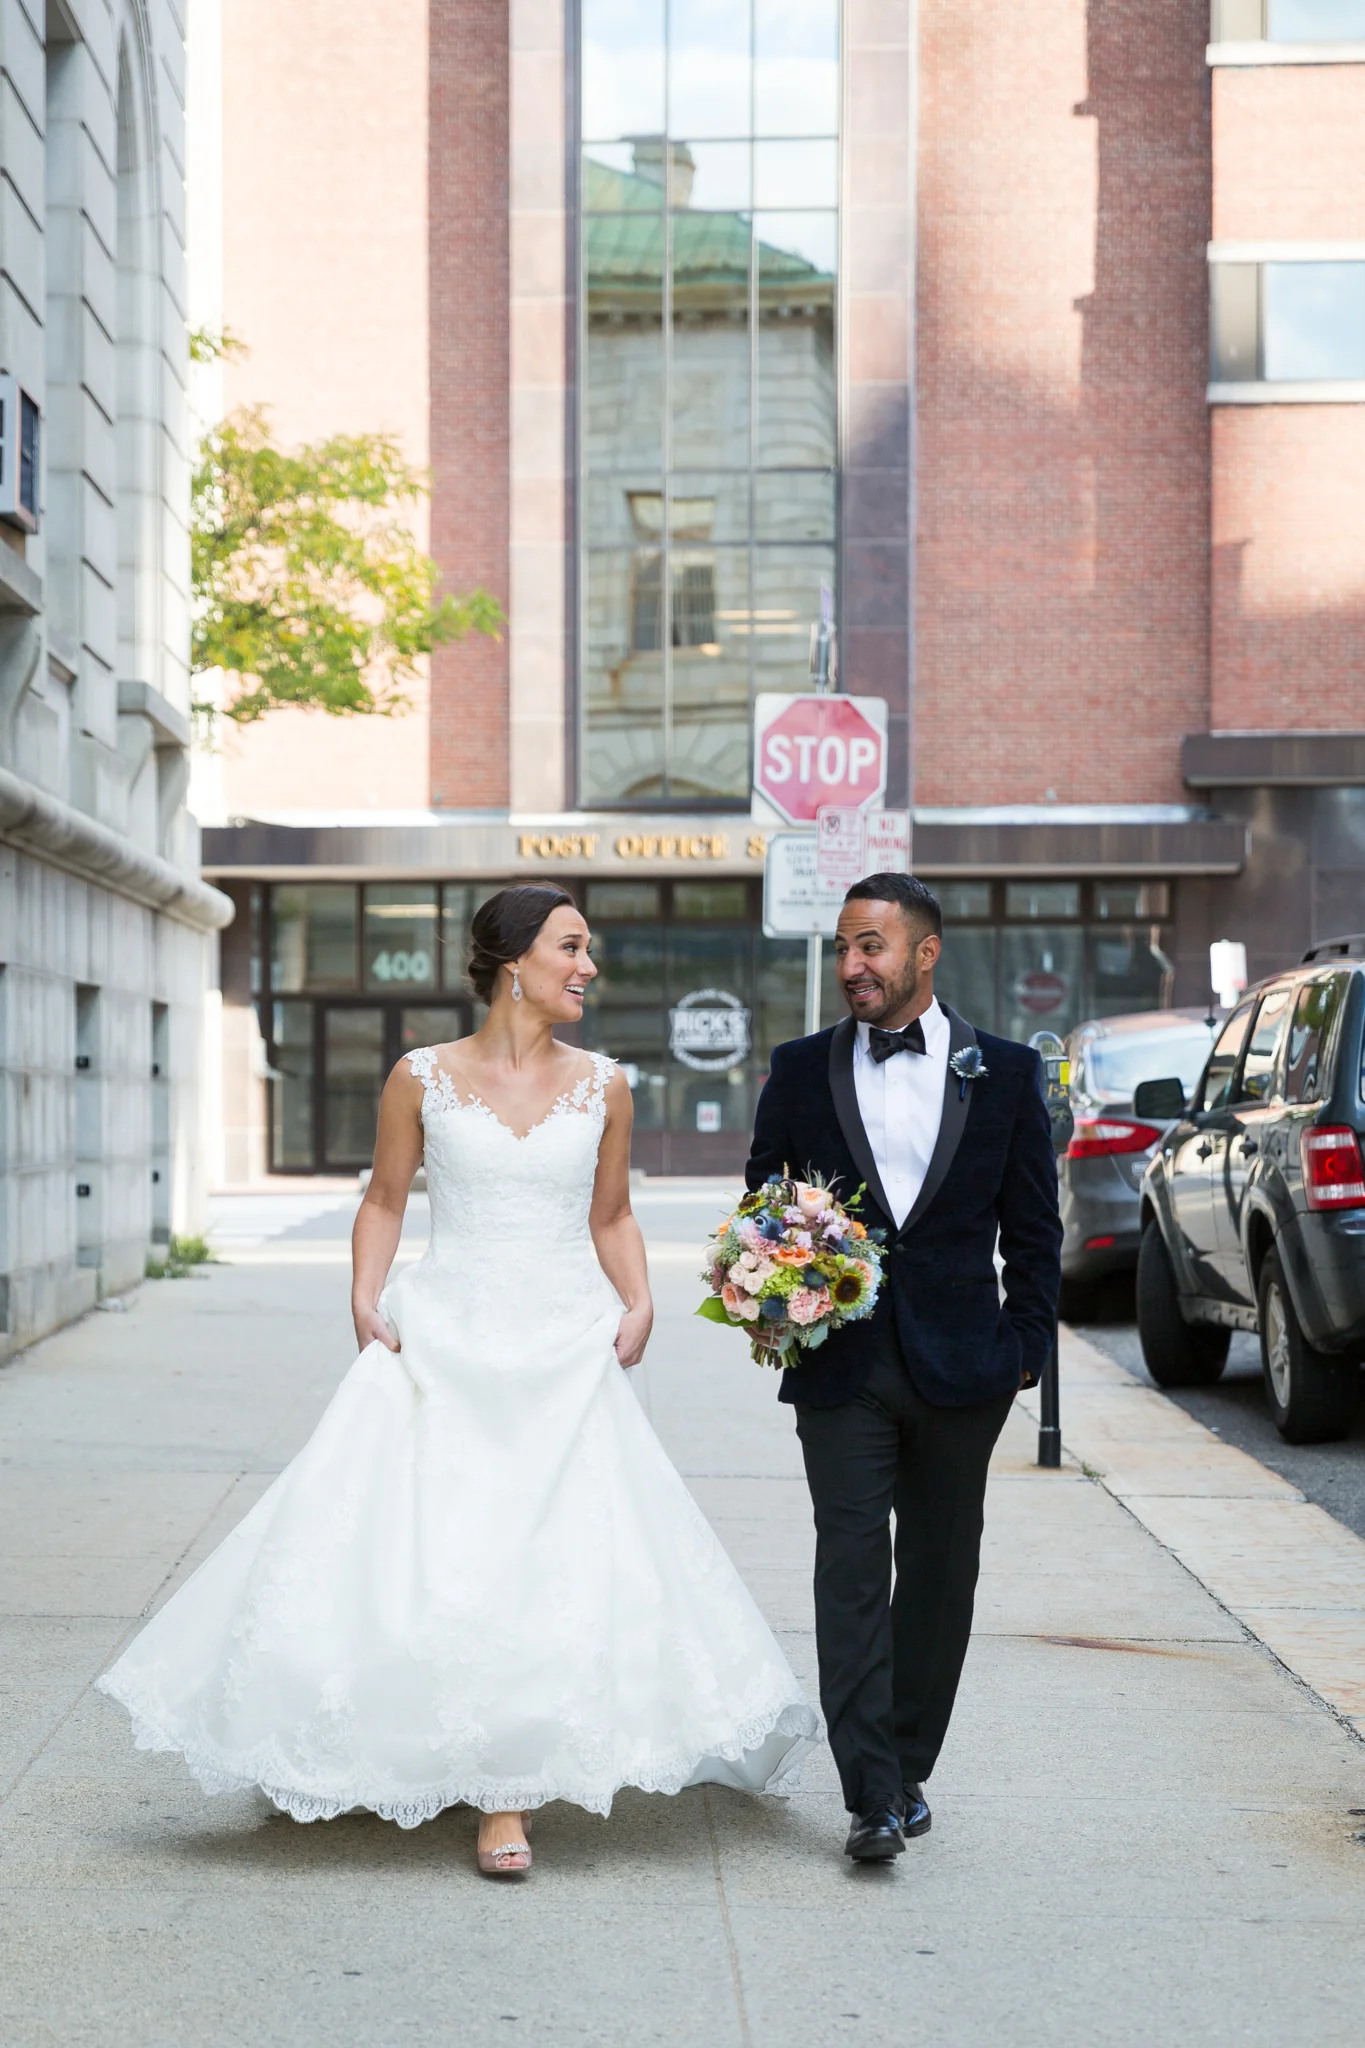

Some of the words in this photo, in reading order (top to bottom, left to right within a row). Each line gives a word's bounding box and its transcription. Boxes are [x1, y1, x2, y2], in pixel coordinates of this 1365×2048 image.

[765, 734, 877, 785] STOP
[880, 816, 896, 831] NO
[519, 833, 597, 858] POST
[615, 834, 728, 859] OFFICE
[867, 835, 908, 851] PARKING
[372, 950, 431, 981] 400
